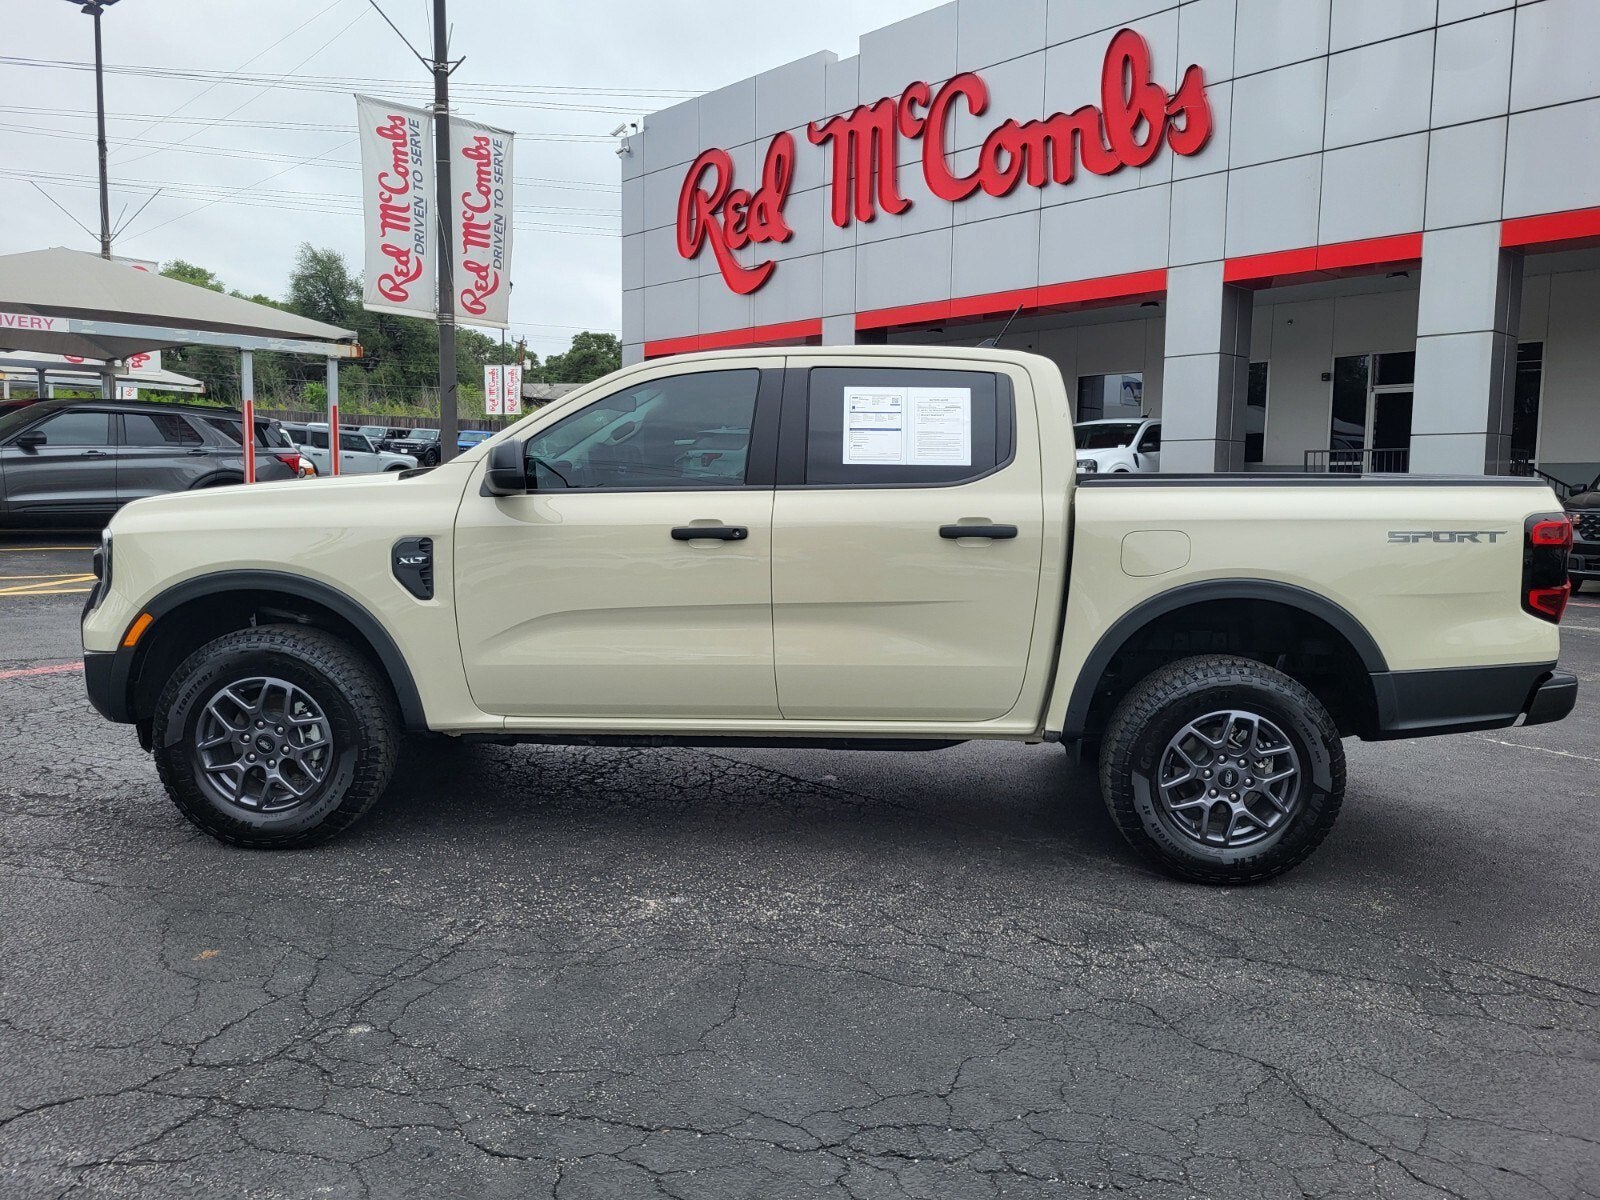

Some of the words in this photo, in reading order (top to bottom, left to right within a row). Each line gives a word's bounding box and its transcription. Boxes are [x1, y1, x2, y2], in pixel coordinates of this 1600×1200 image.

[408, 117, 423, 167] SERVE
[493, 138, 504, 186] SERVE
[676, 131, 795, 295] Red
[807, 29, 1213, 228] McCombs
[376, 114, 411, 238] McCombs
[412, 169, 424, 190] TO
[461, 136, 492, 255] McCombs
[494, 188, 504, 209] TO
[414, 195, 425, 256] DRIVEN
[493, 213, 504, 271] DRIVEN
[377, 243, 423, 303] Red
[460, 259, 499, 316] Red
[398, 556, 427, 565] XLT
[1387, 530, 1508, 544] SPORT
